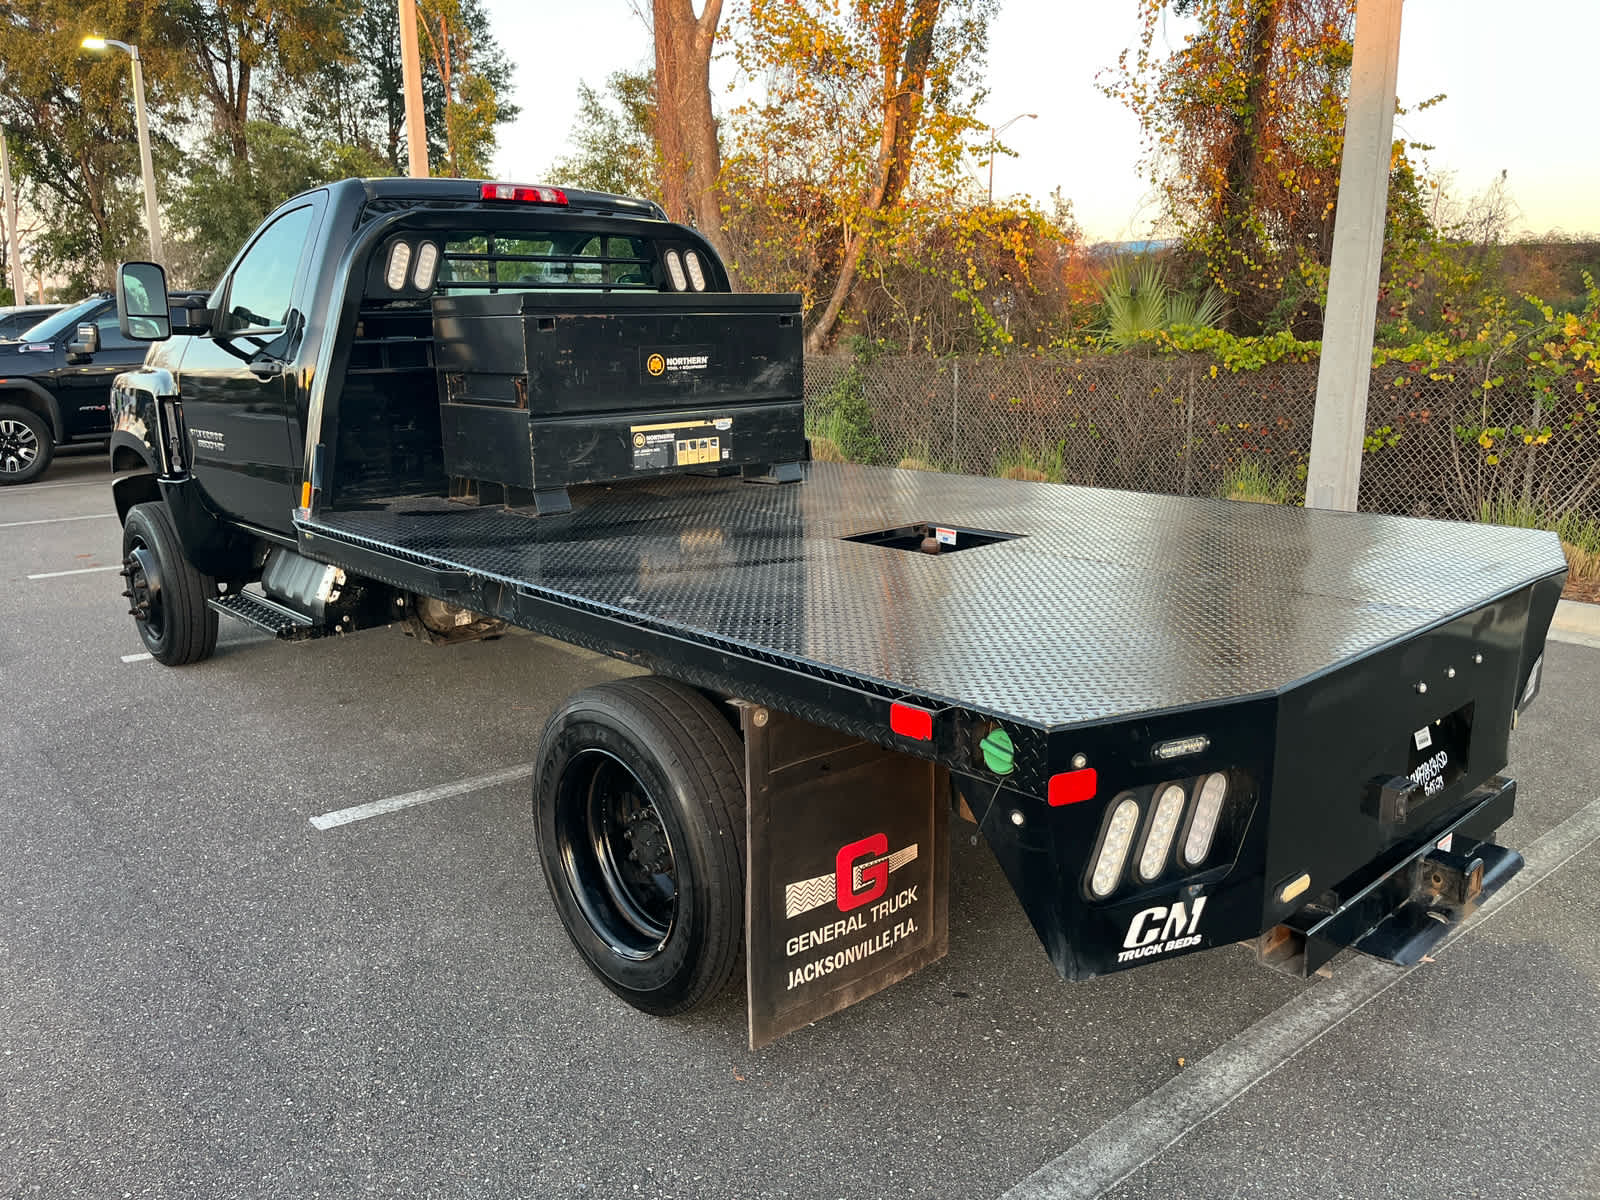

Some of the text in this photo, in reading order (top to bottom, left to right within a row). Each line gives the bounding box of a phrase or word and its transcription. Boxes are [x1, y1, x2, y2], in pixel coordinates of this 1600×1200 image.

[666, 356, 708, 366] NORTHERN
[786, 885, 918, 957] GENERAL TRUCK
[1123, 896, 1208, 949] CM
[1118, 934, 1202, 963] TRUCK BEDS
